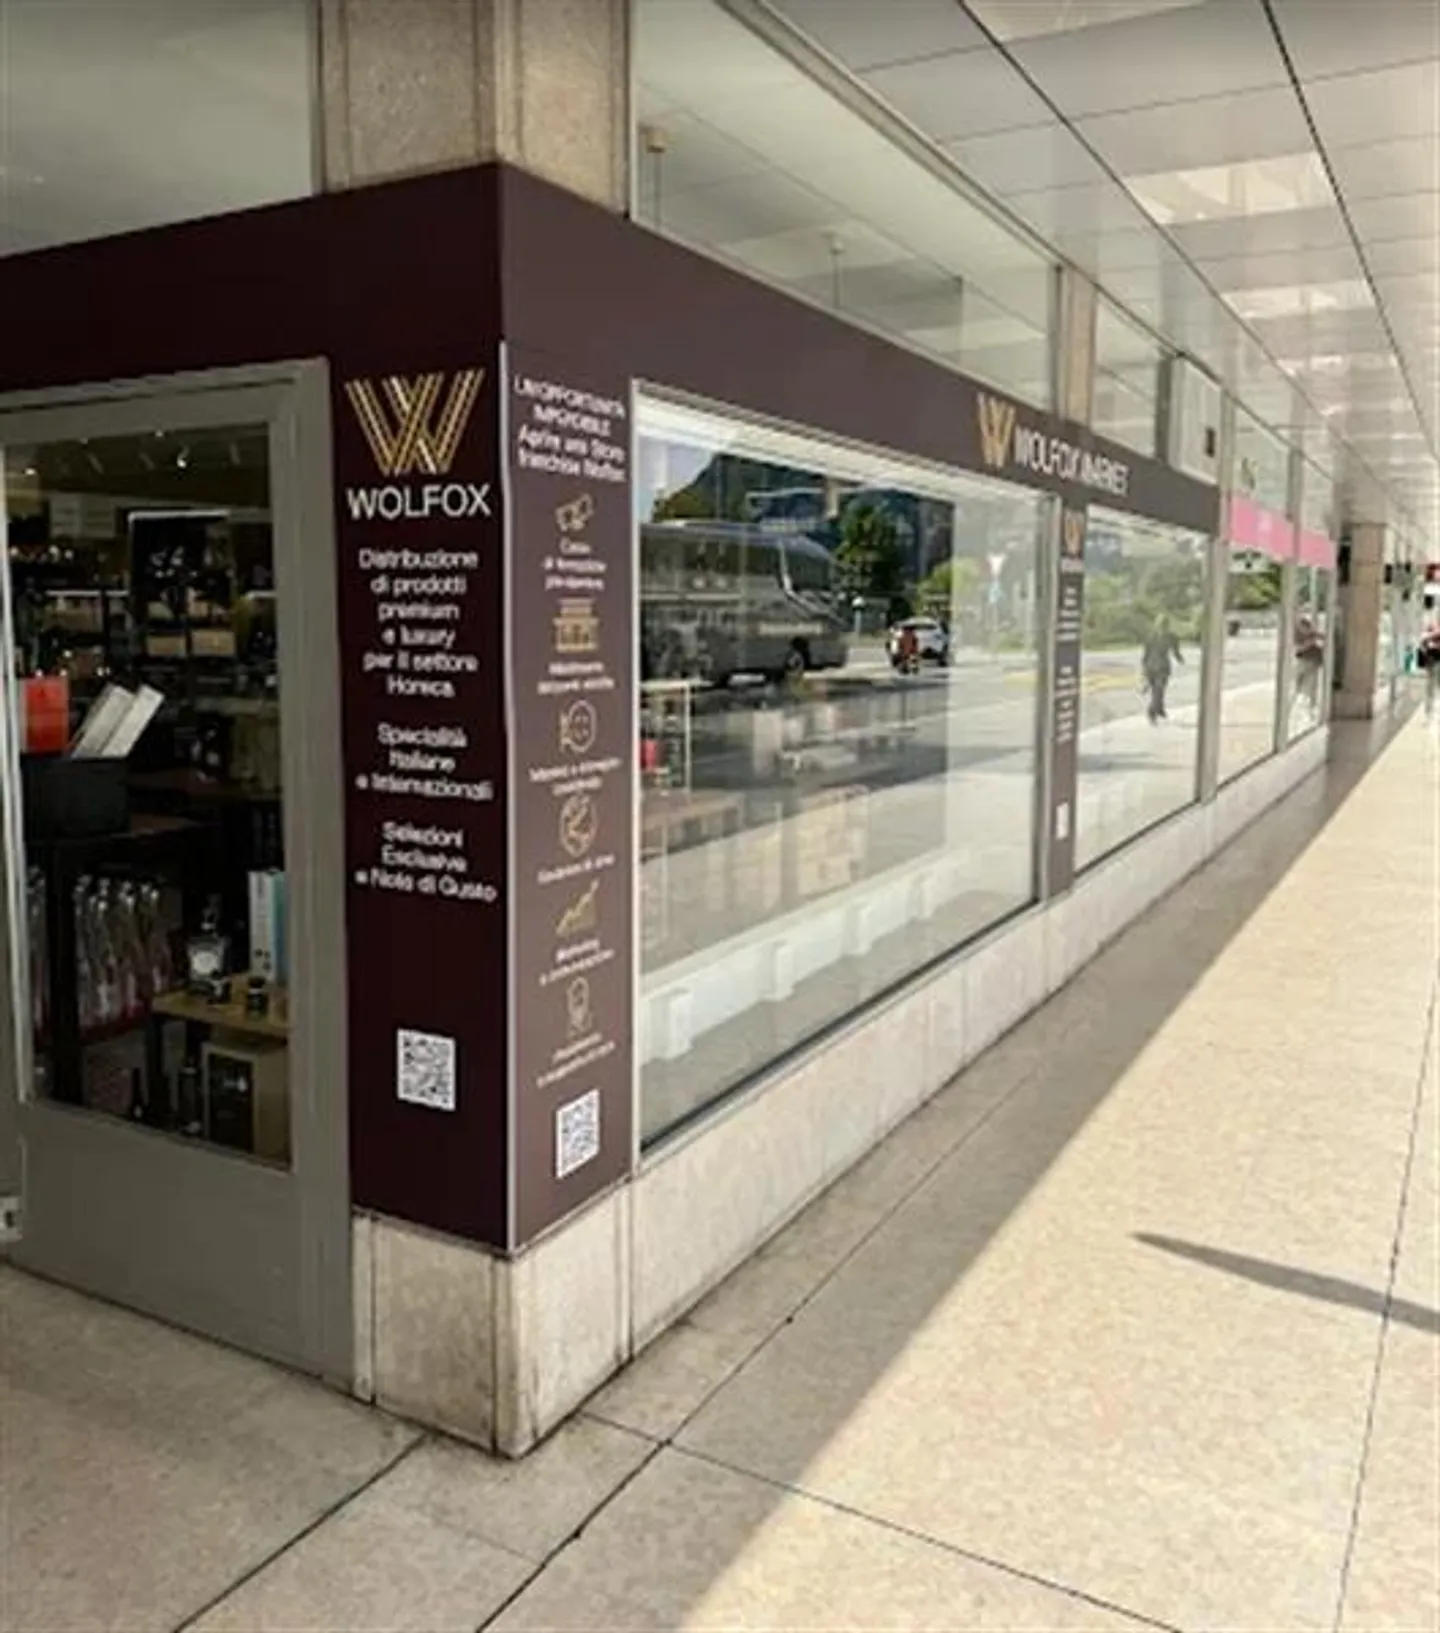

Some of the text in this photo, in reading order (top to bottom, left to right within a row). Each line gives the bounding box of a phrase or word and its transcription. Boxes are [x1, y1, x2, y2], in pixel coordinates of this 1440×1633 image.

[347, 483, 491, 519] WOLFOX
[359, 548, 479, 569] Distribuzione
[370, 574, 467, 598] di prodotti
[378, 602, 460, 622] premium
[382, 625, 456, 650] e luxury
[363, 652, 394, 672] per
[371, 772, 493, 800] Internazionali
[382, 821, 464, 848] Selezioni
